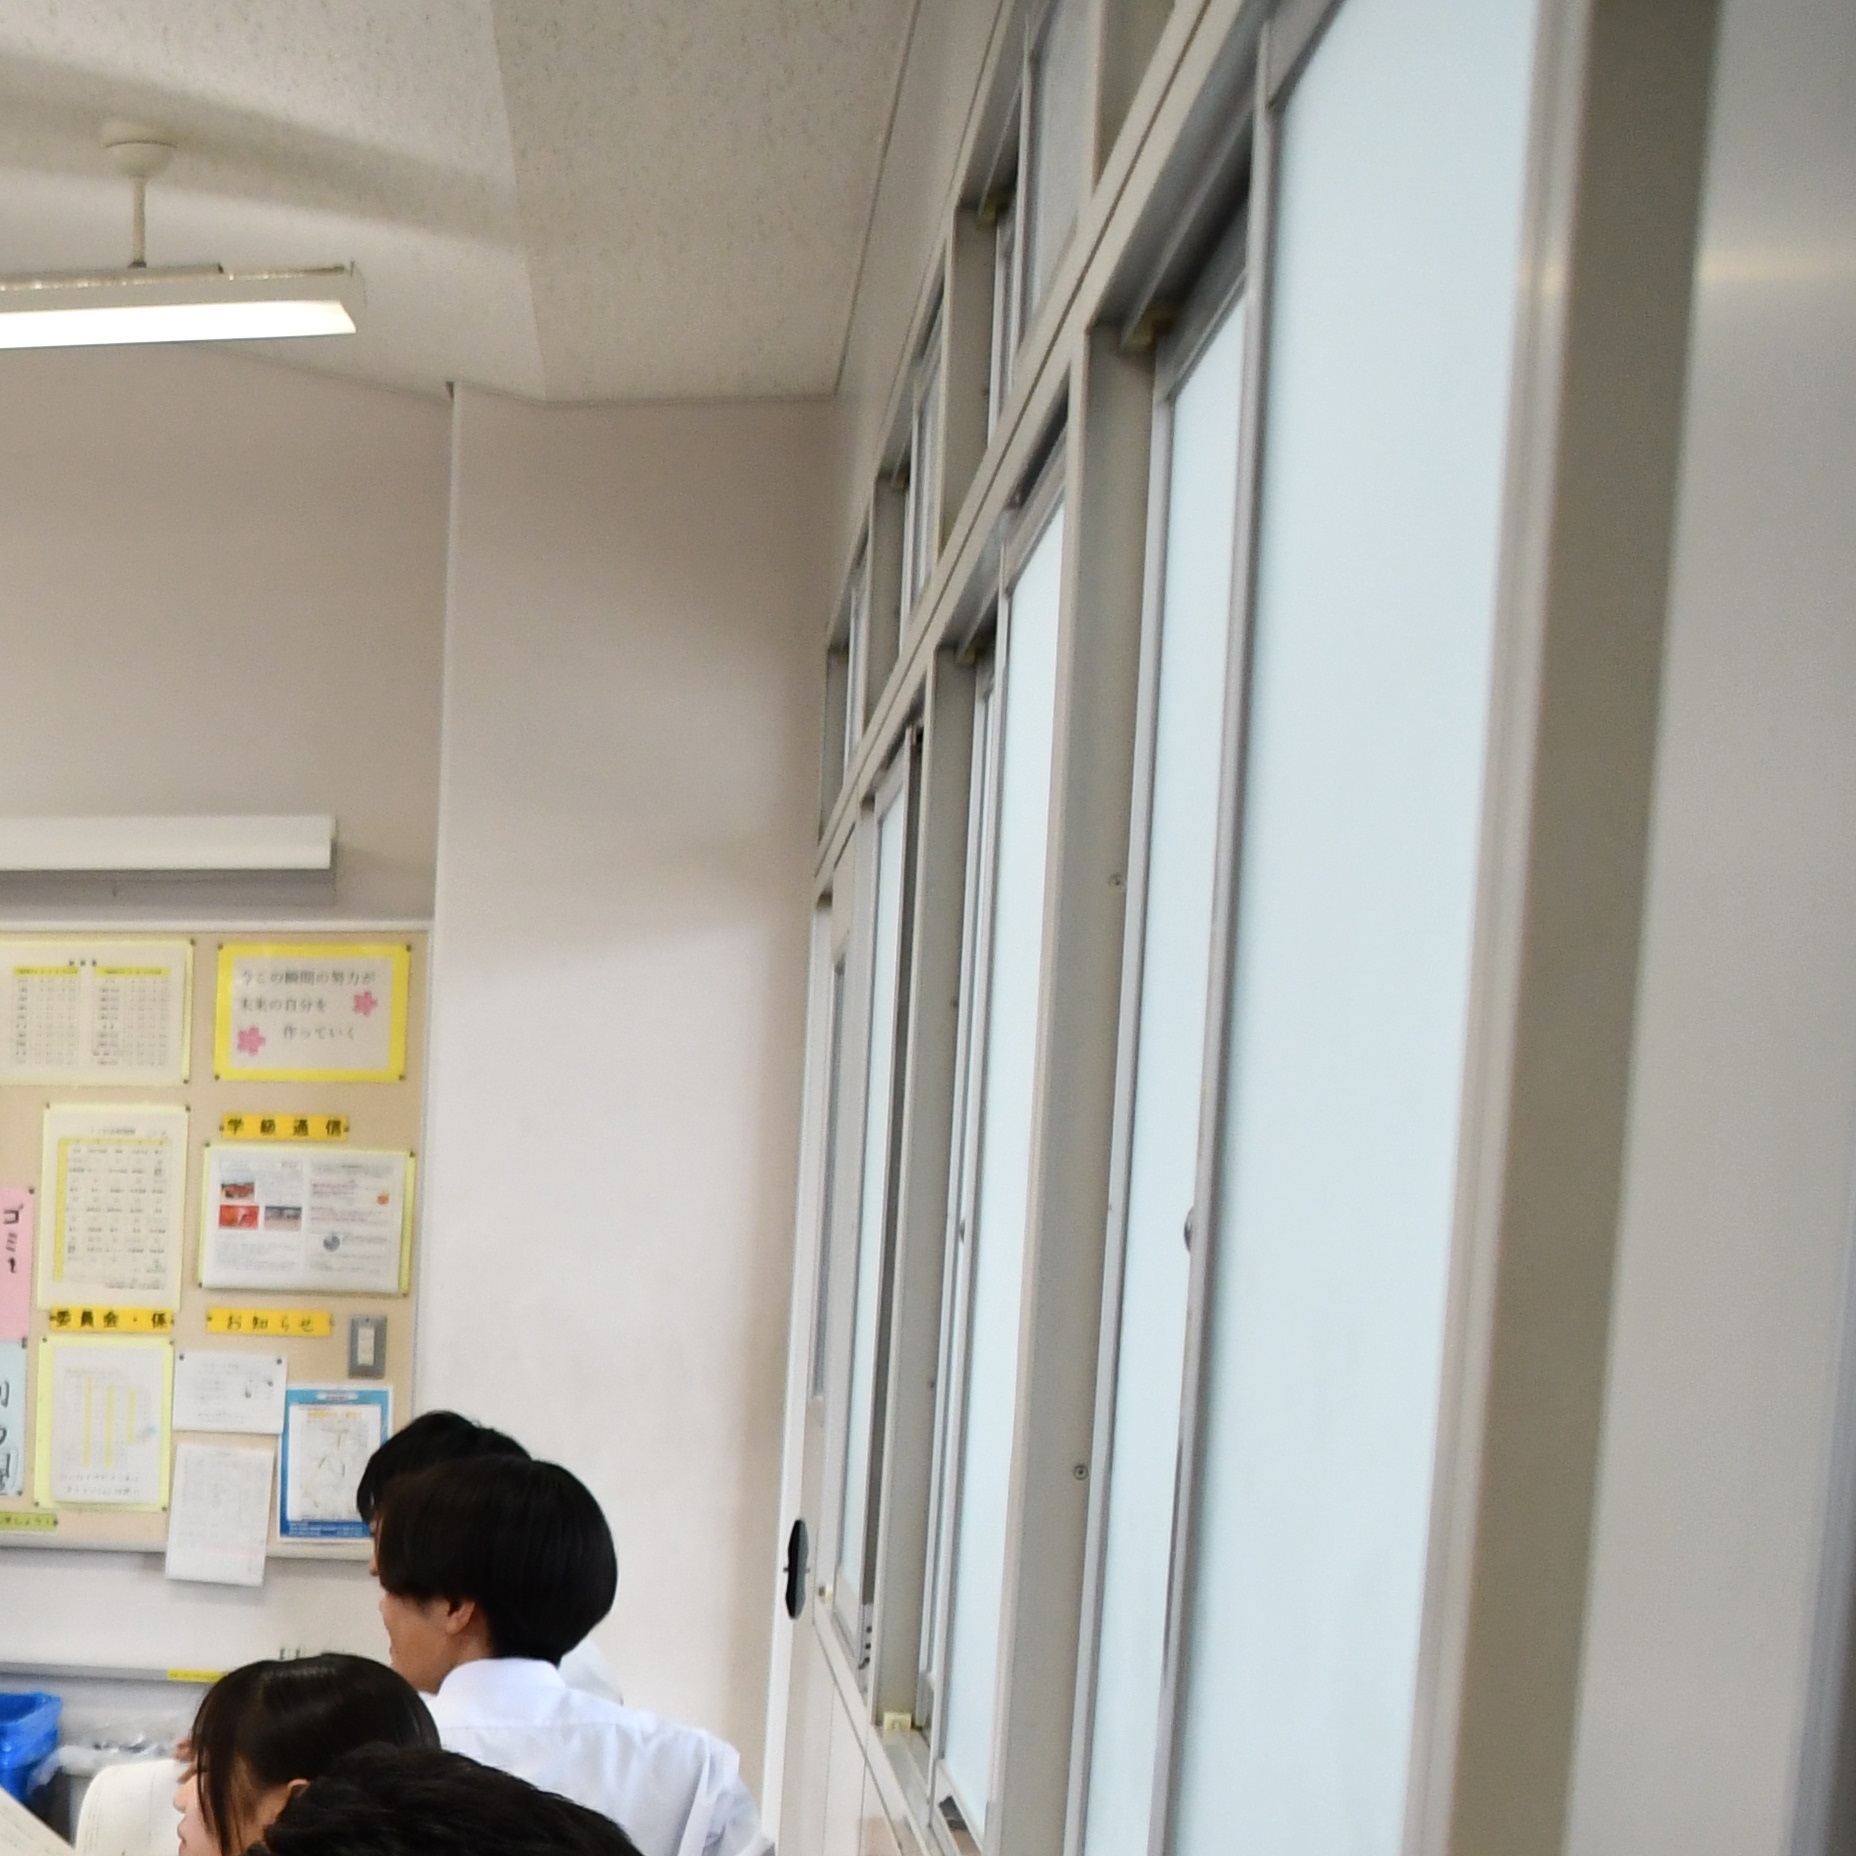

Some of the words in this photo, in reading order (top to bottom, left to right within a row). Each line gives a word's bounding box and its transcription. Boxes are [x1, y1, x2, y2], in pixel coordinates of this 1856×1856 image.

[227, 1118, 342, 1137] 学級通信
[56, 1309, 167, 1329] 委員会・係
[226, 1314, 314, 1333] お知らせ
